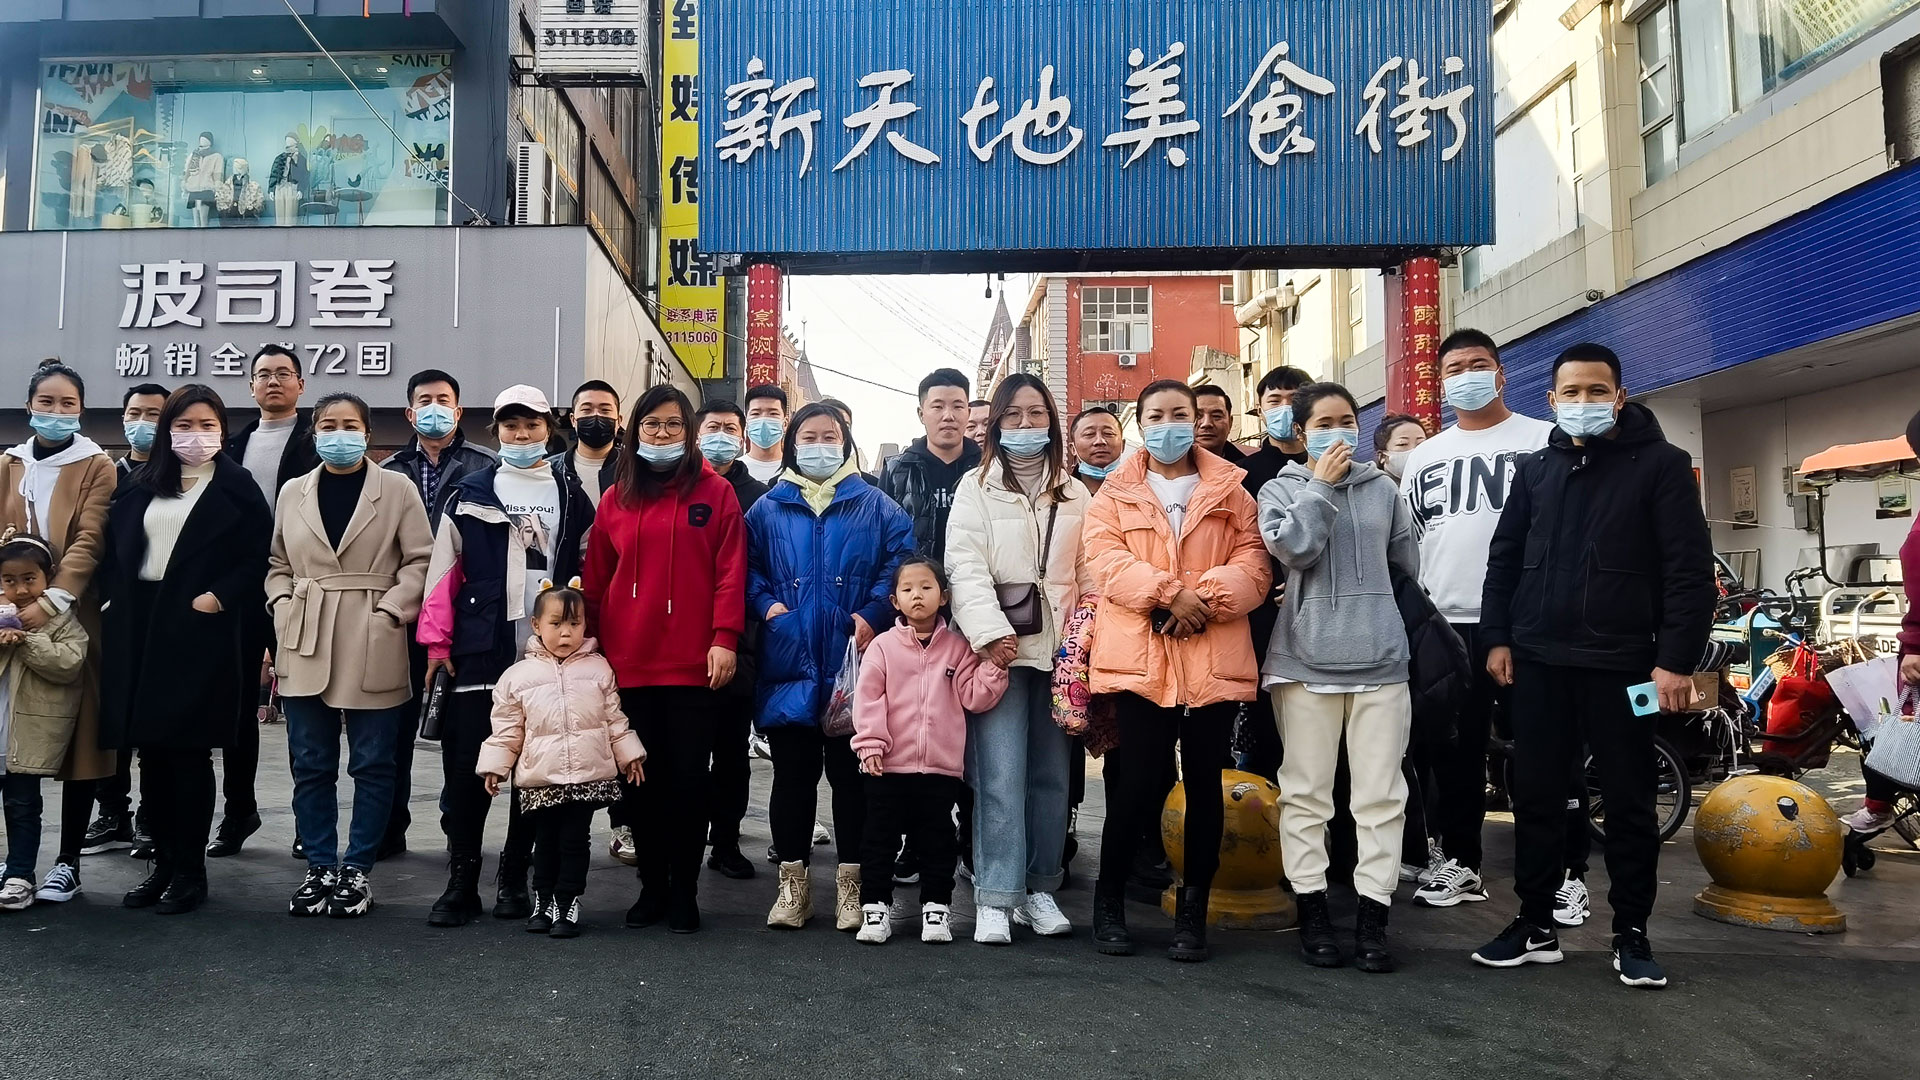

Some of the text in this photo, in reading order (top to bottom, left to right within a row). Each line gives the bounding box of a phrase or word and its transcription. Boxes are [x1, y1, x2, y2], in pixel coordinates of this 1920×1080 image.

[544, 27, 636, 46] 3115060
[715, 40, 1475, 178] 新天地美食街
[118, 258, 396, 330] 波司登
[667, 308, 718, 323] 联系电话
[666, 331, 718, 343] 3115060
[115, 341, 392, 377] 畅销全72国
